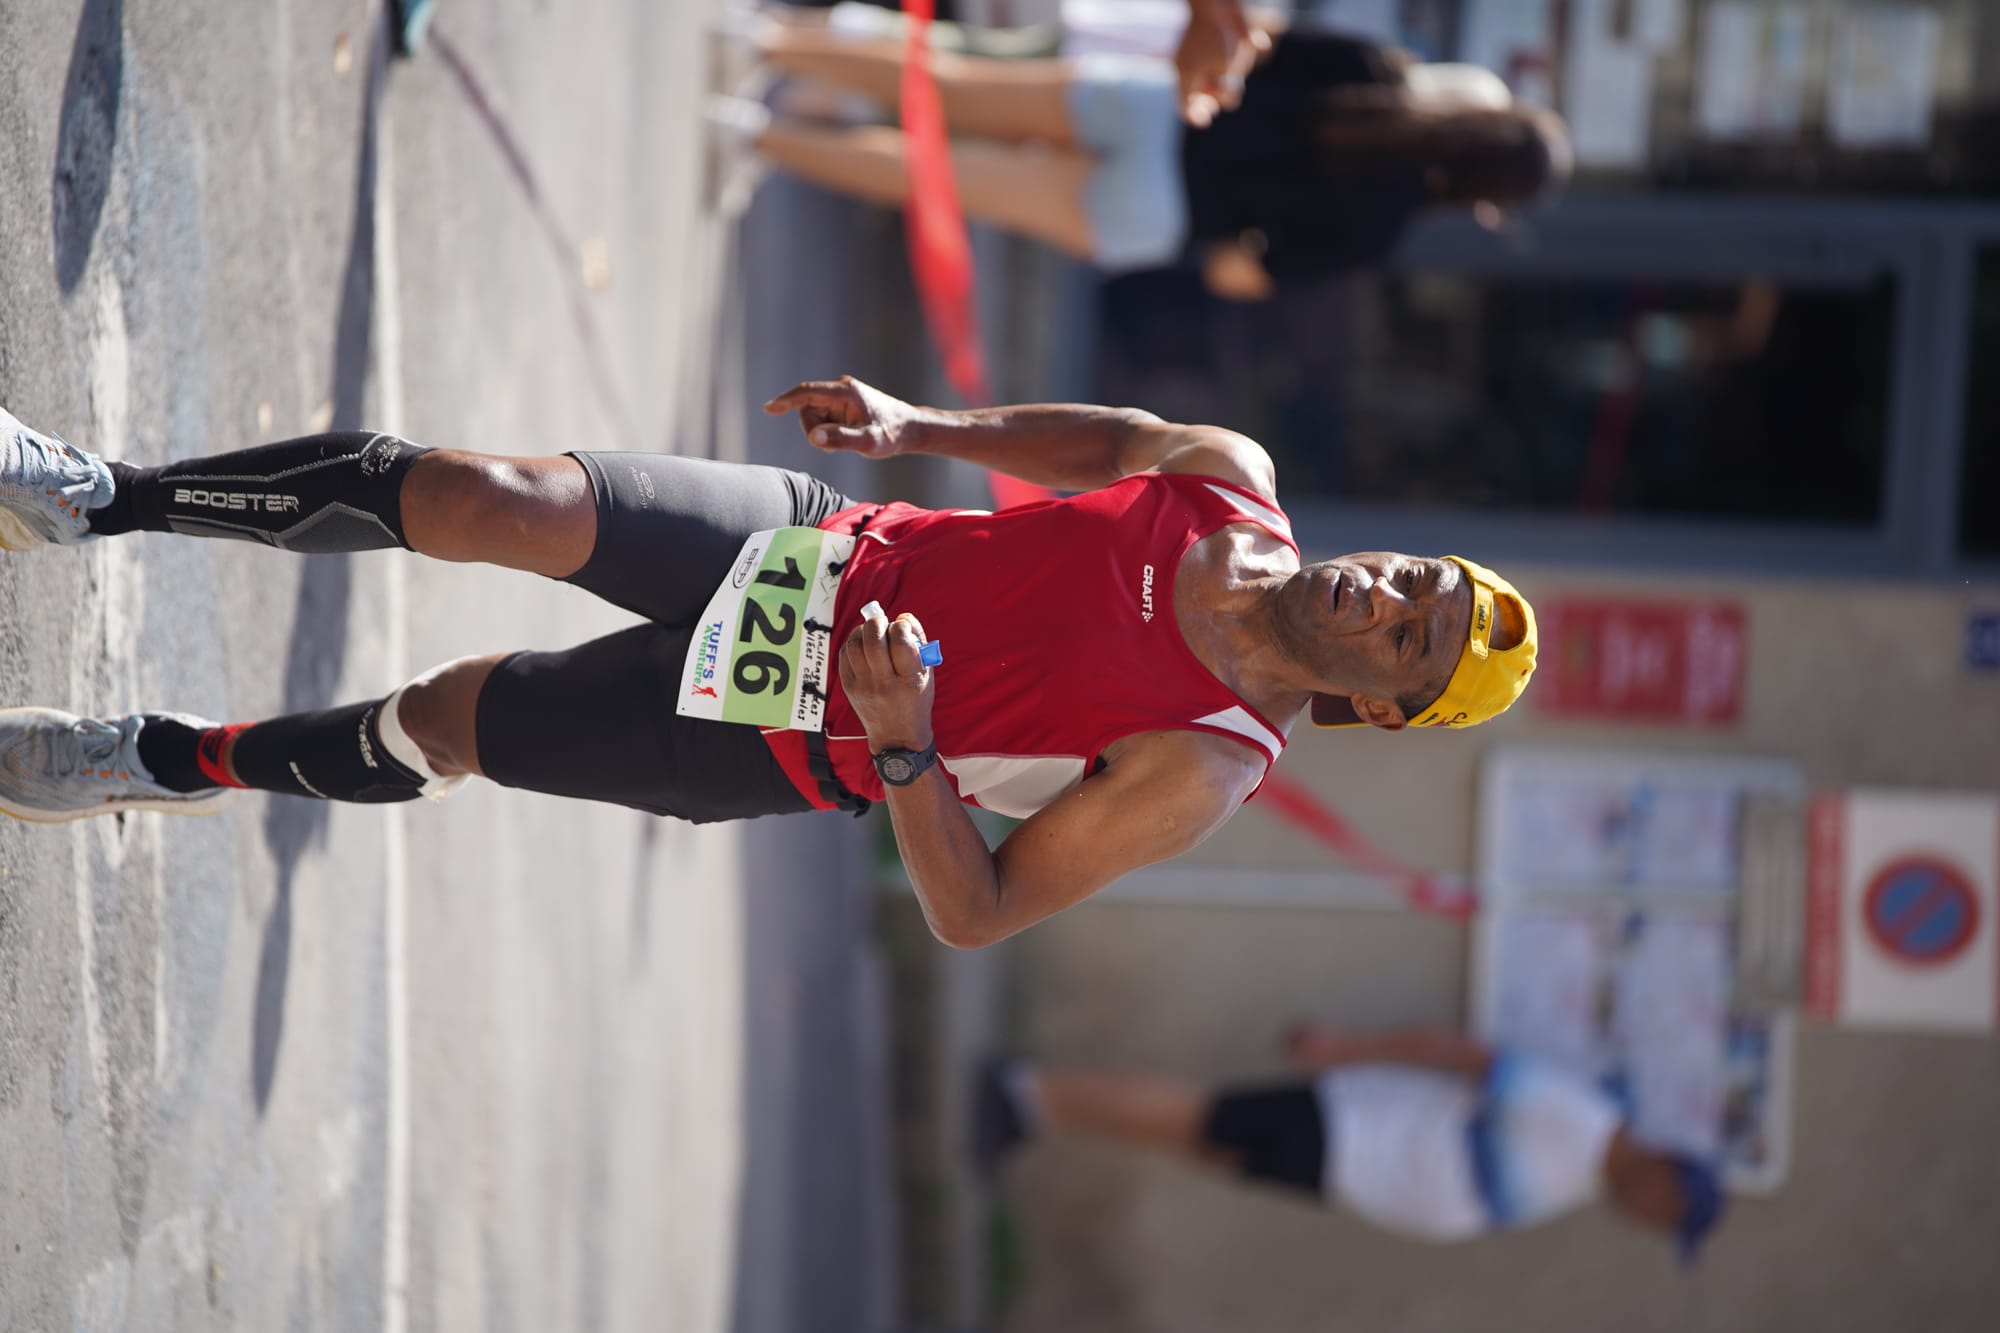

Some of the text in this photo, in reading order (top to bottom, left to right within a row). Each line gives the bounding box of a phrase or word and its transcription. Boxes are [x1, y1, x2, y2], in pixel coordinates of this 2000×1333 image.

[174, 487, 300, 513] BOOSTER
[1142, 564, 1154, 611] CRAFT
[693, 625, 714, 684] Aventure
[702, 620, 724, 680] TUFF'S
[731, 556, 807, 696] 126
[812, 631, 828, 687] hallenge
